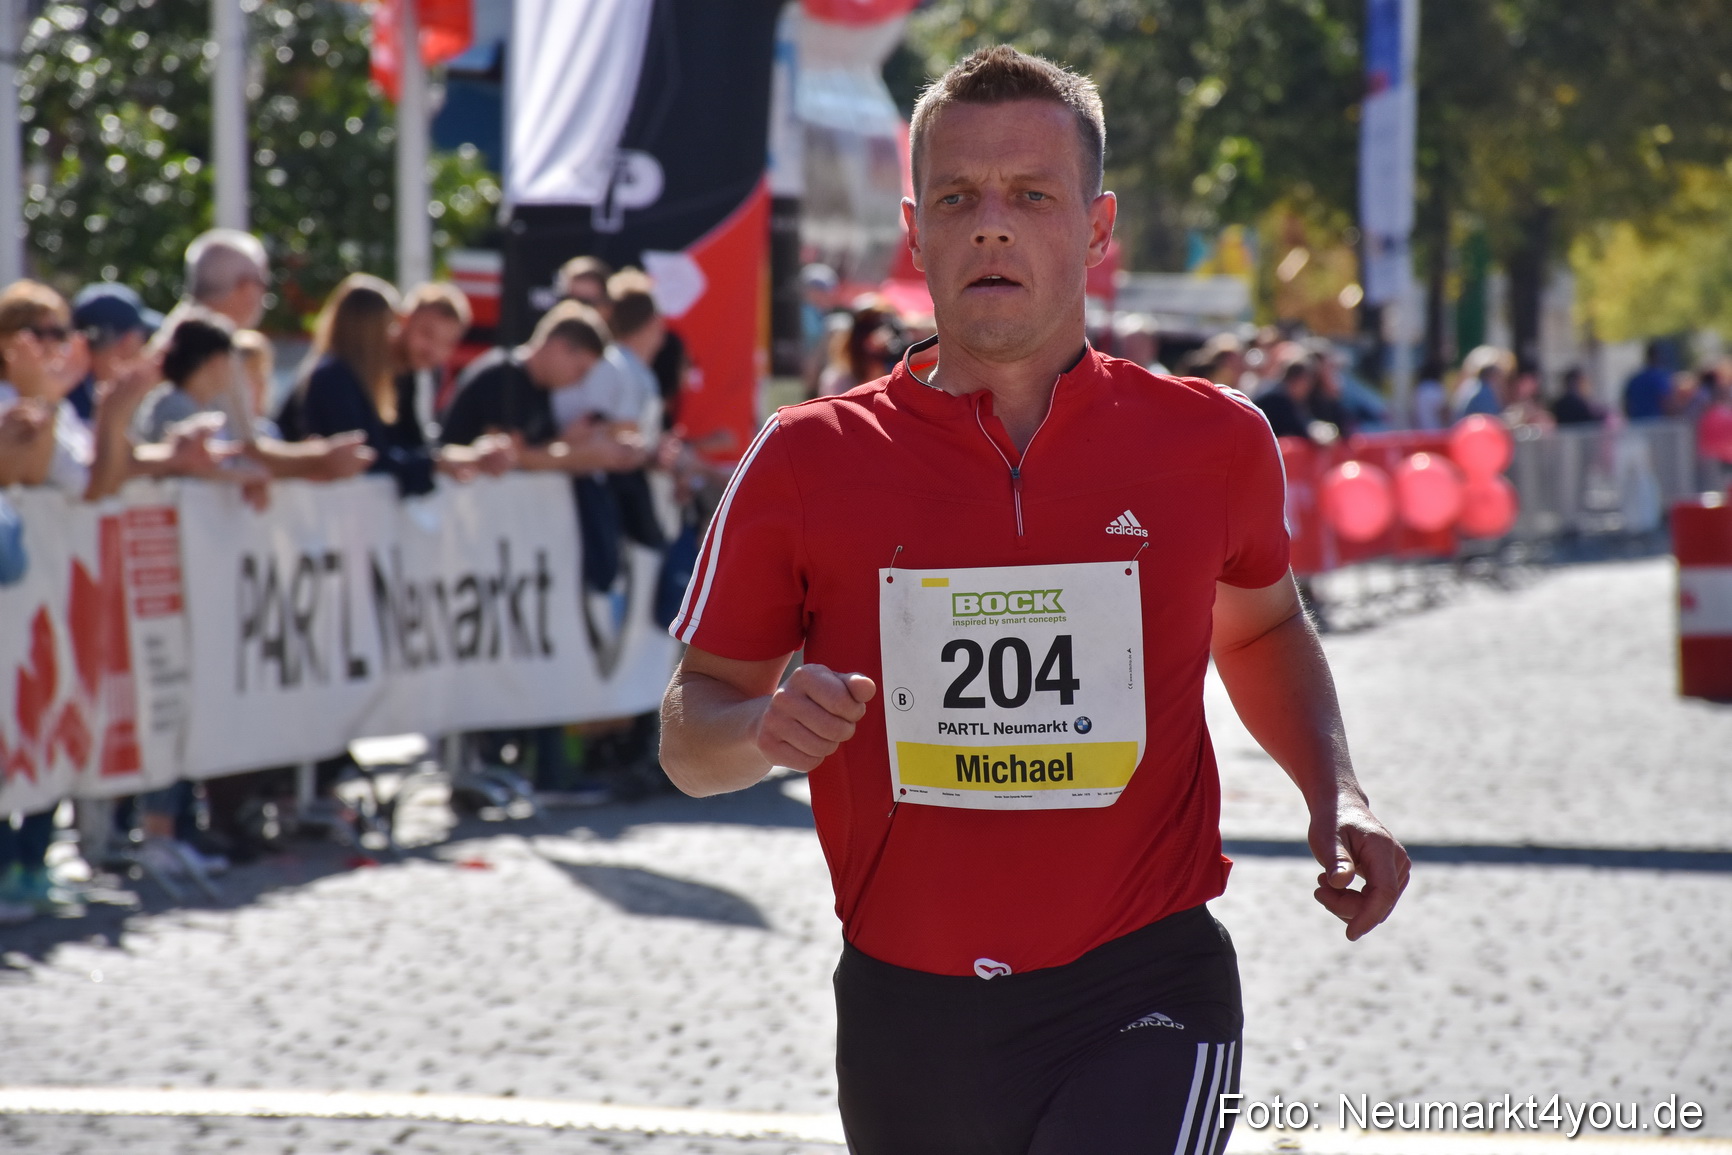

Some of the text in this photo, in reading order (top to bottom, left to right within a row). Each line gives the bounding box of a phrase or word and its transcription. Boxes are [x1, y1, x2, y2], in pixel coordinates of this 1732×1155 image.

[1105, 525, 1149, 538] adidas
[370, 536, 554, 673] Nearkt
[952, 589, 1066, 617] BOCK
[952, 615, 1067, 627] inspired by smart concepts
[940, 634, 1080, 709] 204
[898, 693, 907, 706] B
[938, 721, 990, 736] PARTL
[993, 719, 1068, 735] Neumarkt
[955, 752, 1074, 783] Michael
